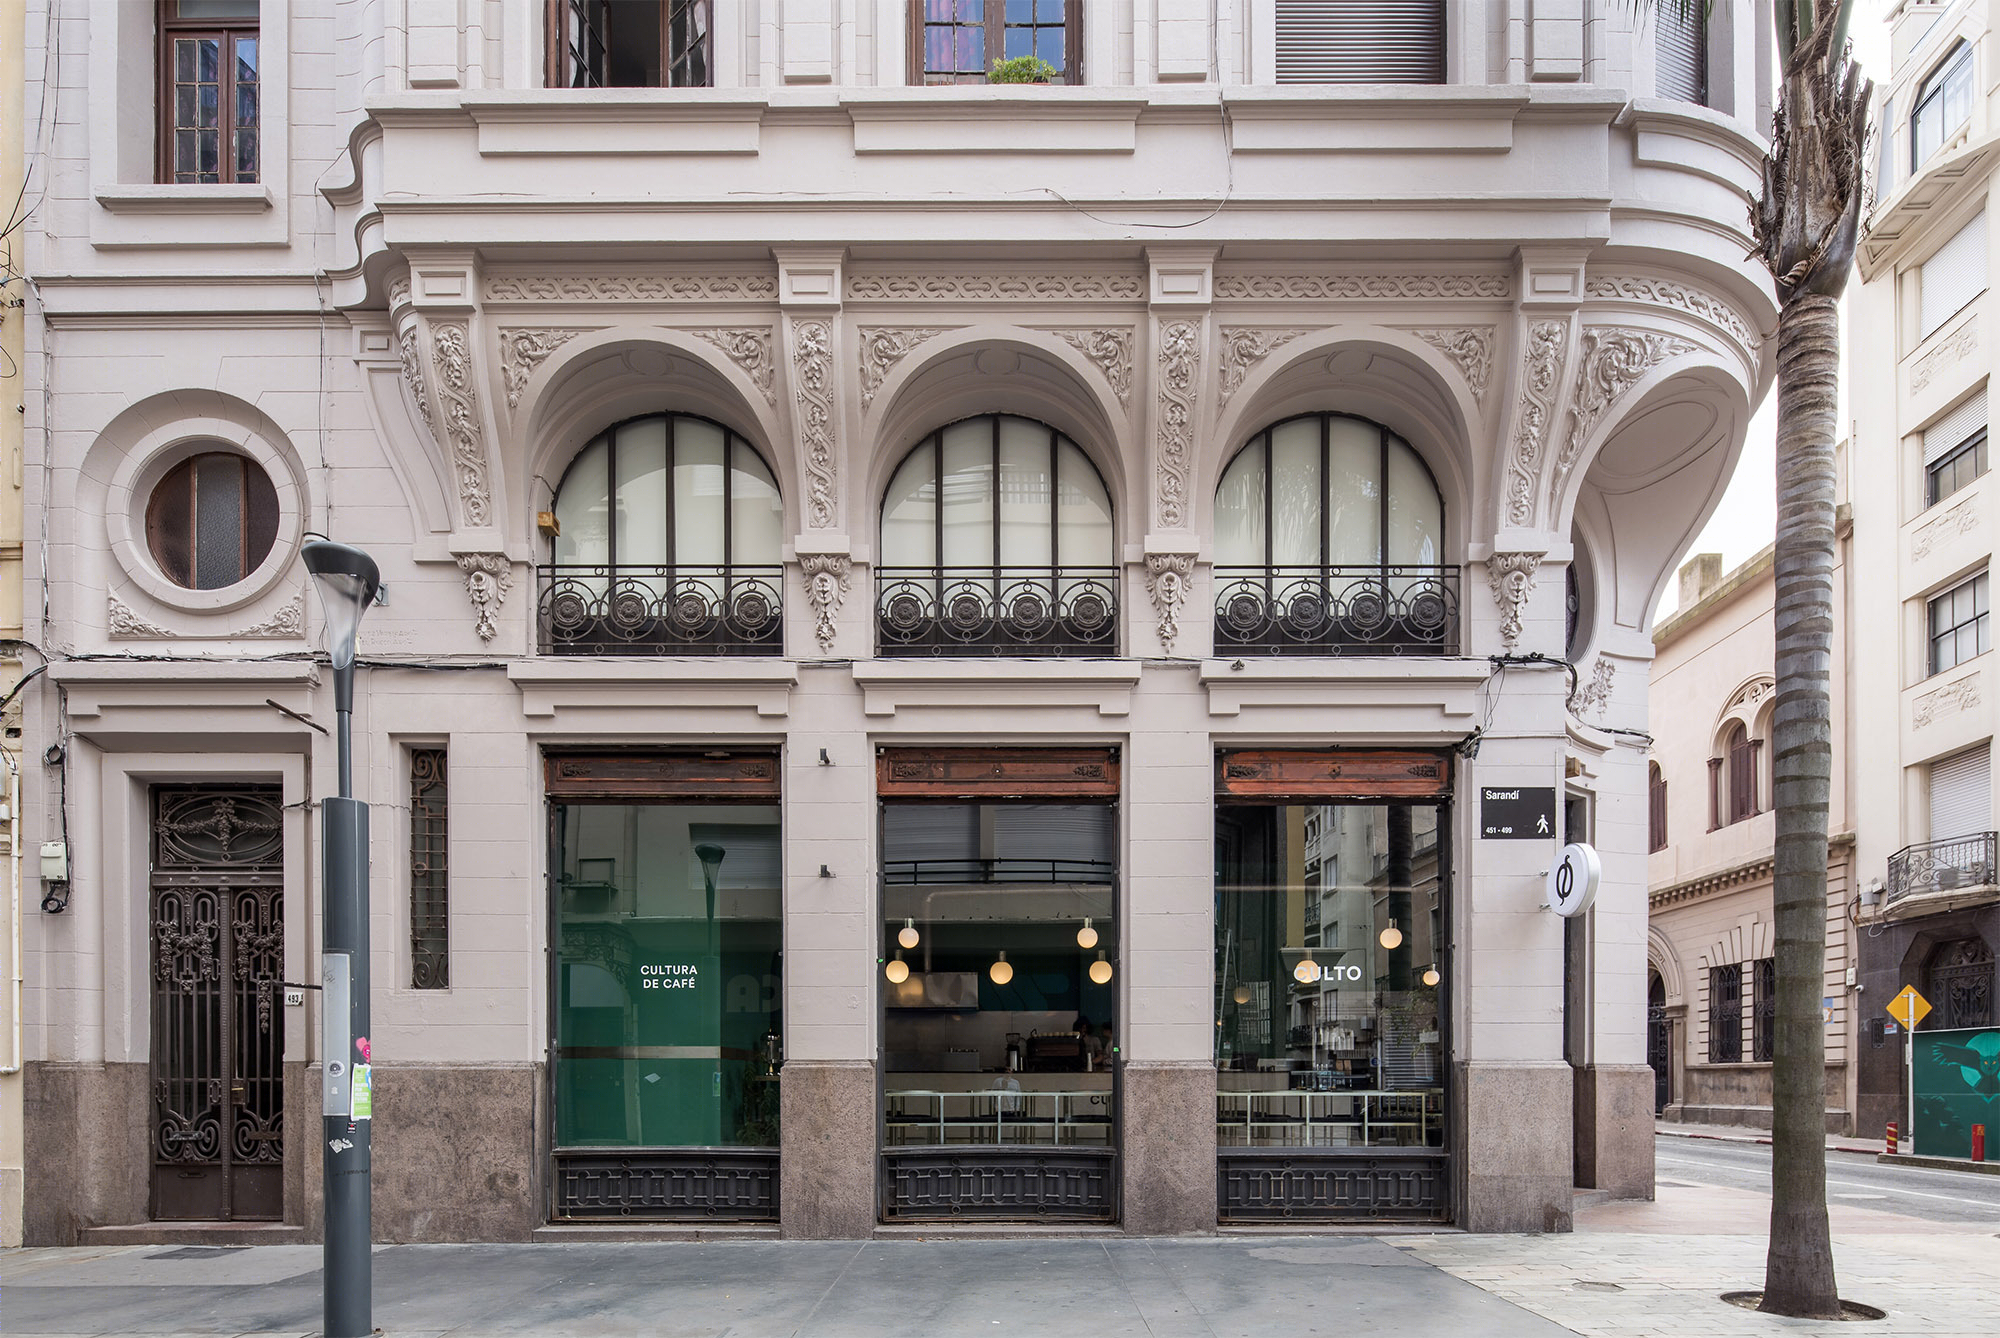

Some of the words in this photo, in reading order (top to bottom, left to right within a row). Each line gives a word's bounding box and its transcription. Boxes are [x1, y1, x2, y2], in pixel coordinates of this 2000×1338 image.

[1485, 790, 1520, 800] Sarandí
[640, 965, 698, 975] CULTURA
[1294, 965, 1362, 981] CULTO
[643, 979, 659, 989] DE
[663, 977, 696, 989] CAFÉ
[287, 994, 299, 1003] 493
